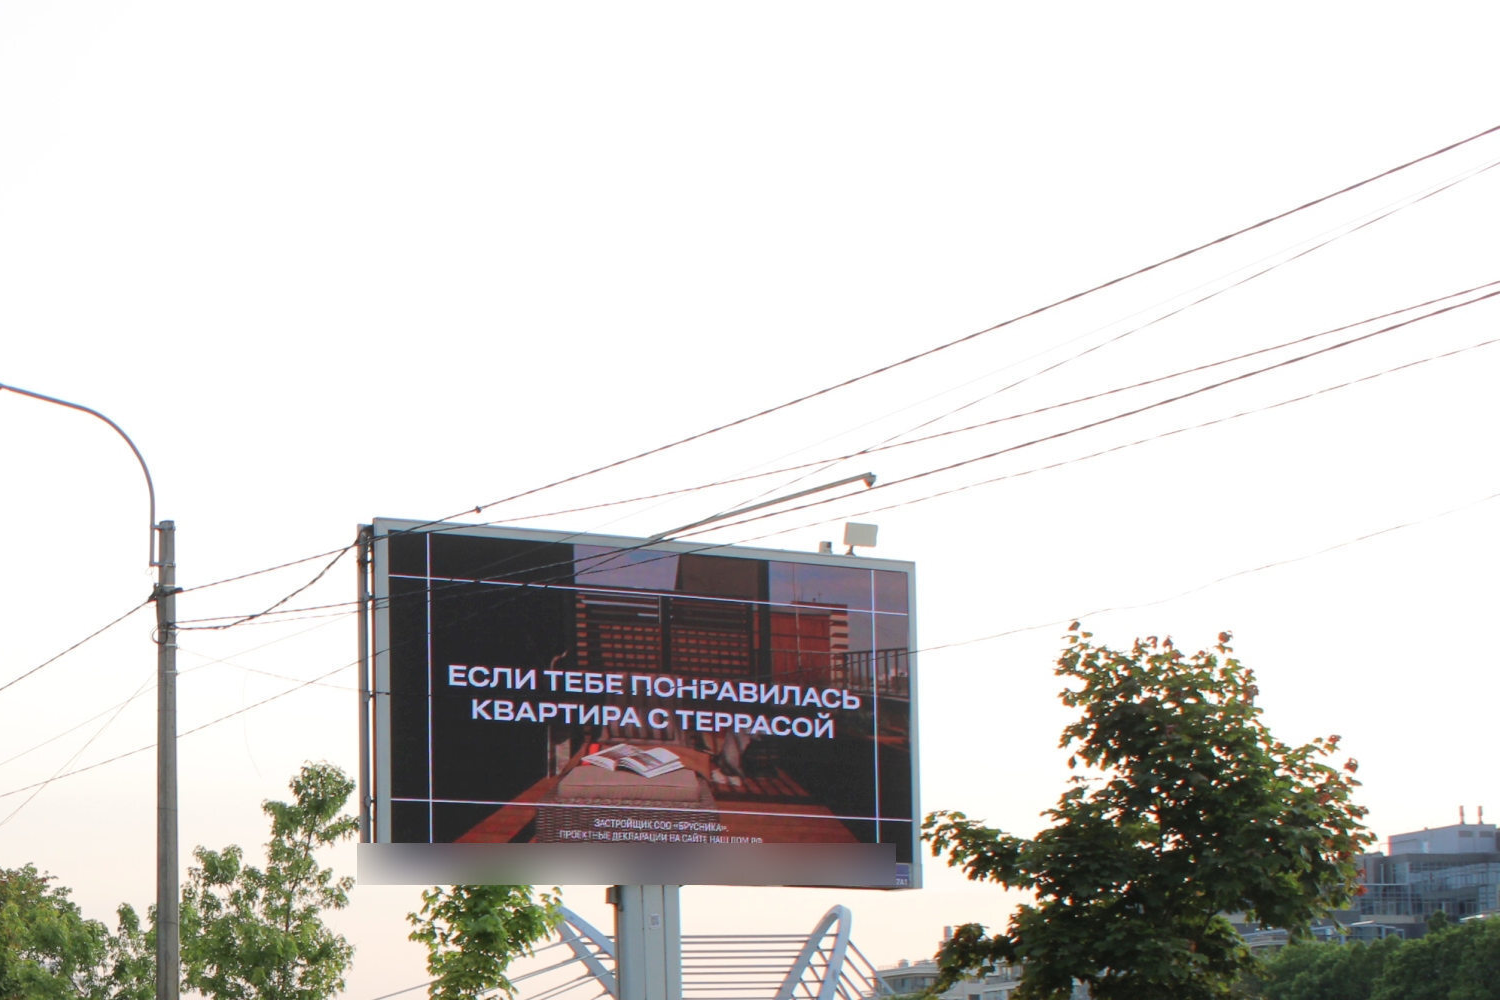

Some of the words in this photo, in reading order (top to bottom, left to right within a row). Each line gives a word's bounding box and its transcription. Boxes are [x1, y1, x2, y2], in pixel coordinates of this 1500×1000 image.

[448, 664, 536, 690] ЕСЛИ
[544, 669, 623, 694] ТЕБЕ
[631, 675, 861, 710] ПОНРАВИЛАСЬ
[471, 699, 641, 728] КВАРТИРА
[648, 708, 669, 729] С
[675, 709, 834, 738] ТЕРРАСОЙ
[594, 818, 652, 830] ЗАСТРОЙЩИК
